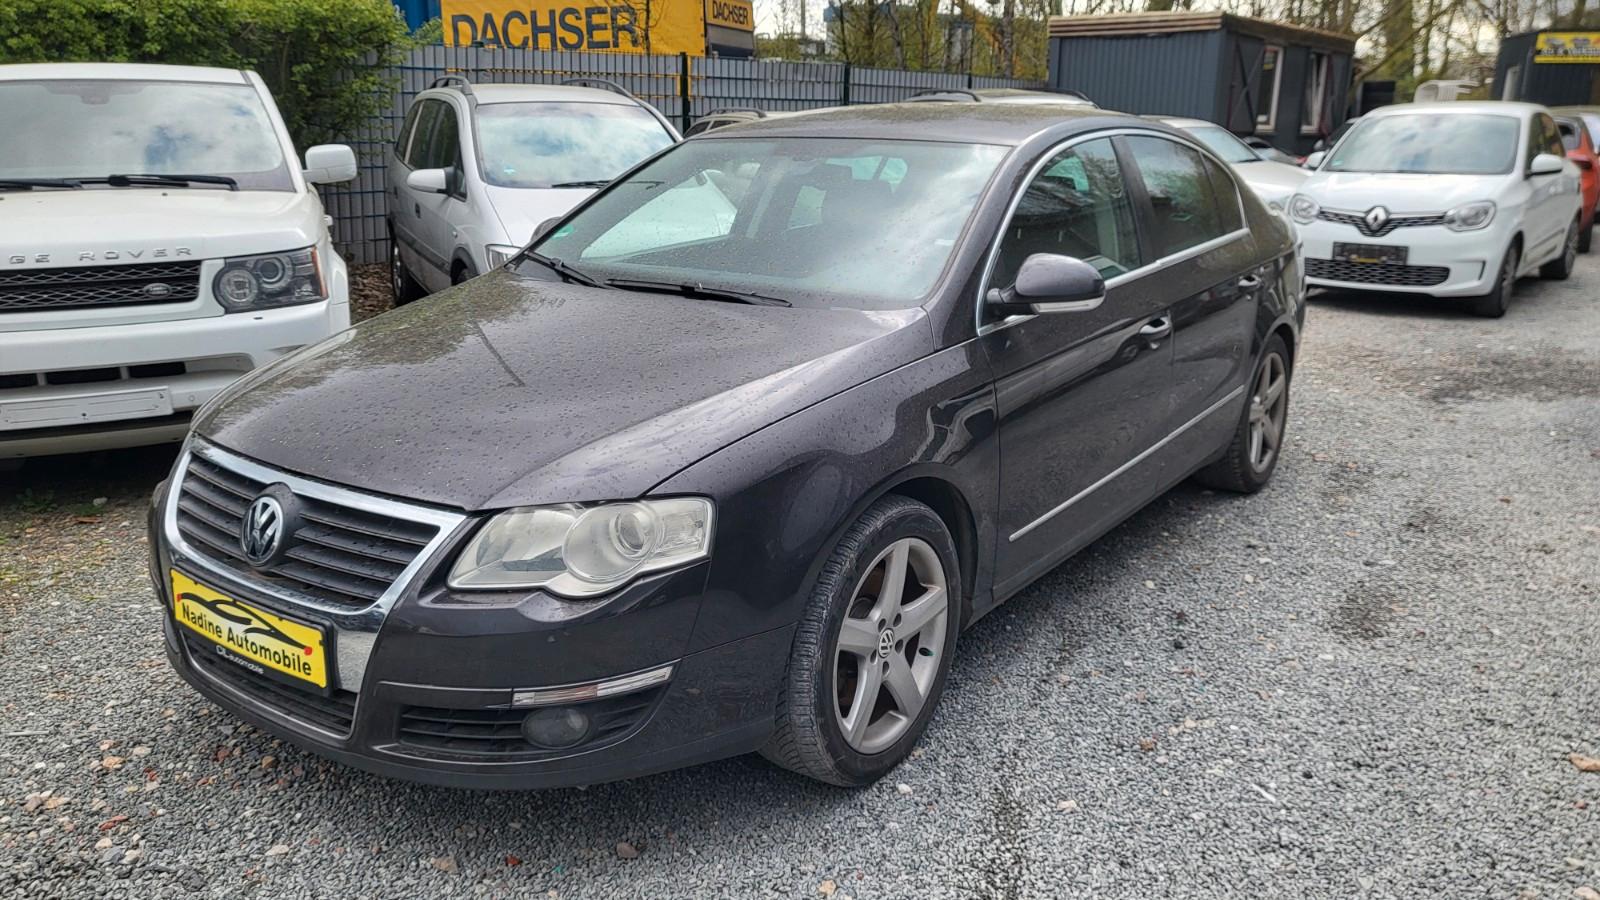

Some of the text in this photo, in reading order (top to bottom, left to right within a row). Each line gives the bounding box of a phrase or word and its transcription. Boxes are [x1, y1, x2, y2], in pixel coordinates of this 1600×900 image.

[451, 5, 641, 50] DACHSER
[712, 0, 749, 25] DACHSER
[78, 247, 193, 262] ROVER
[181, 602, 312, 676] Nadine Automobile
